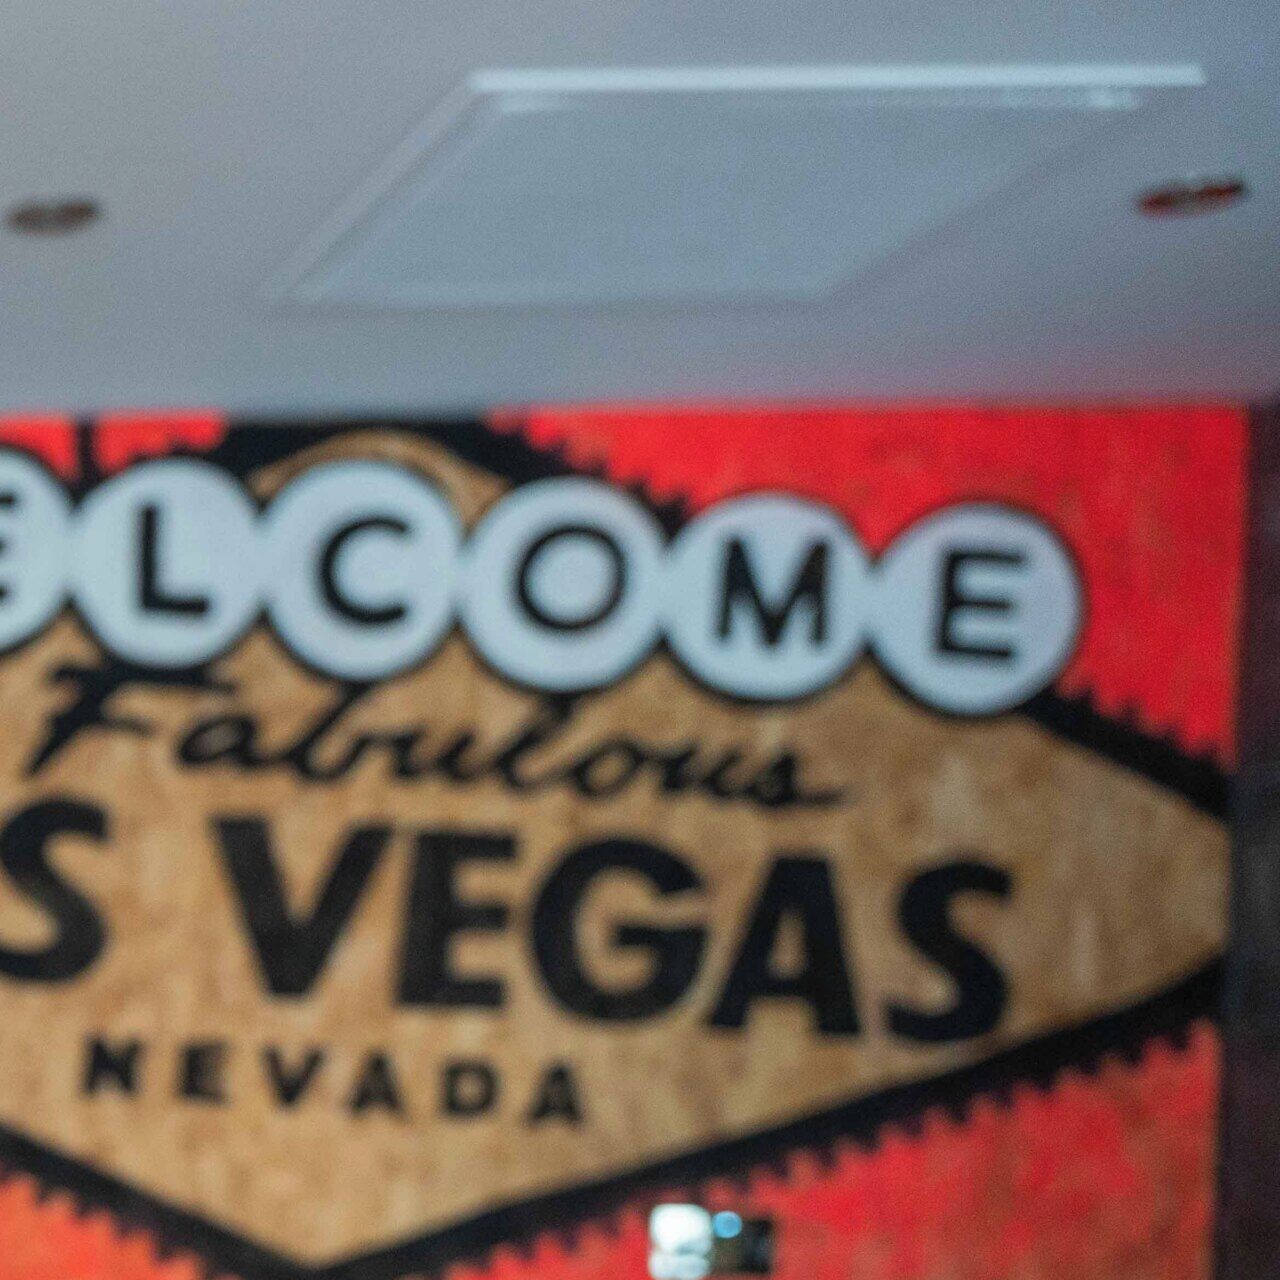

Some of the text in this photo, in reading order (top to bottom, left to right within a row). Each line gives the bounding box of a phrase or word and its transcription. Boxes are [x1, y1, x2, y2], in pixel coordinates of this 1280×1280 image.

[22, 664, 845, 810] Fabulous
[208, 812, 1016, 1044] VEGAS
[80, 1034, 586, 1130] NEVADA
